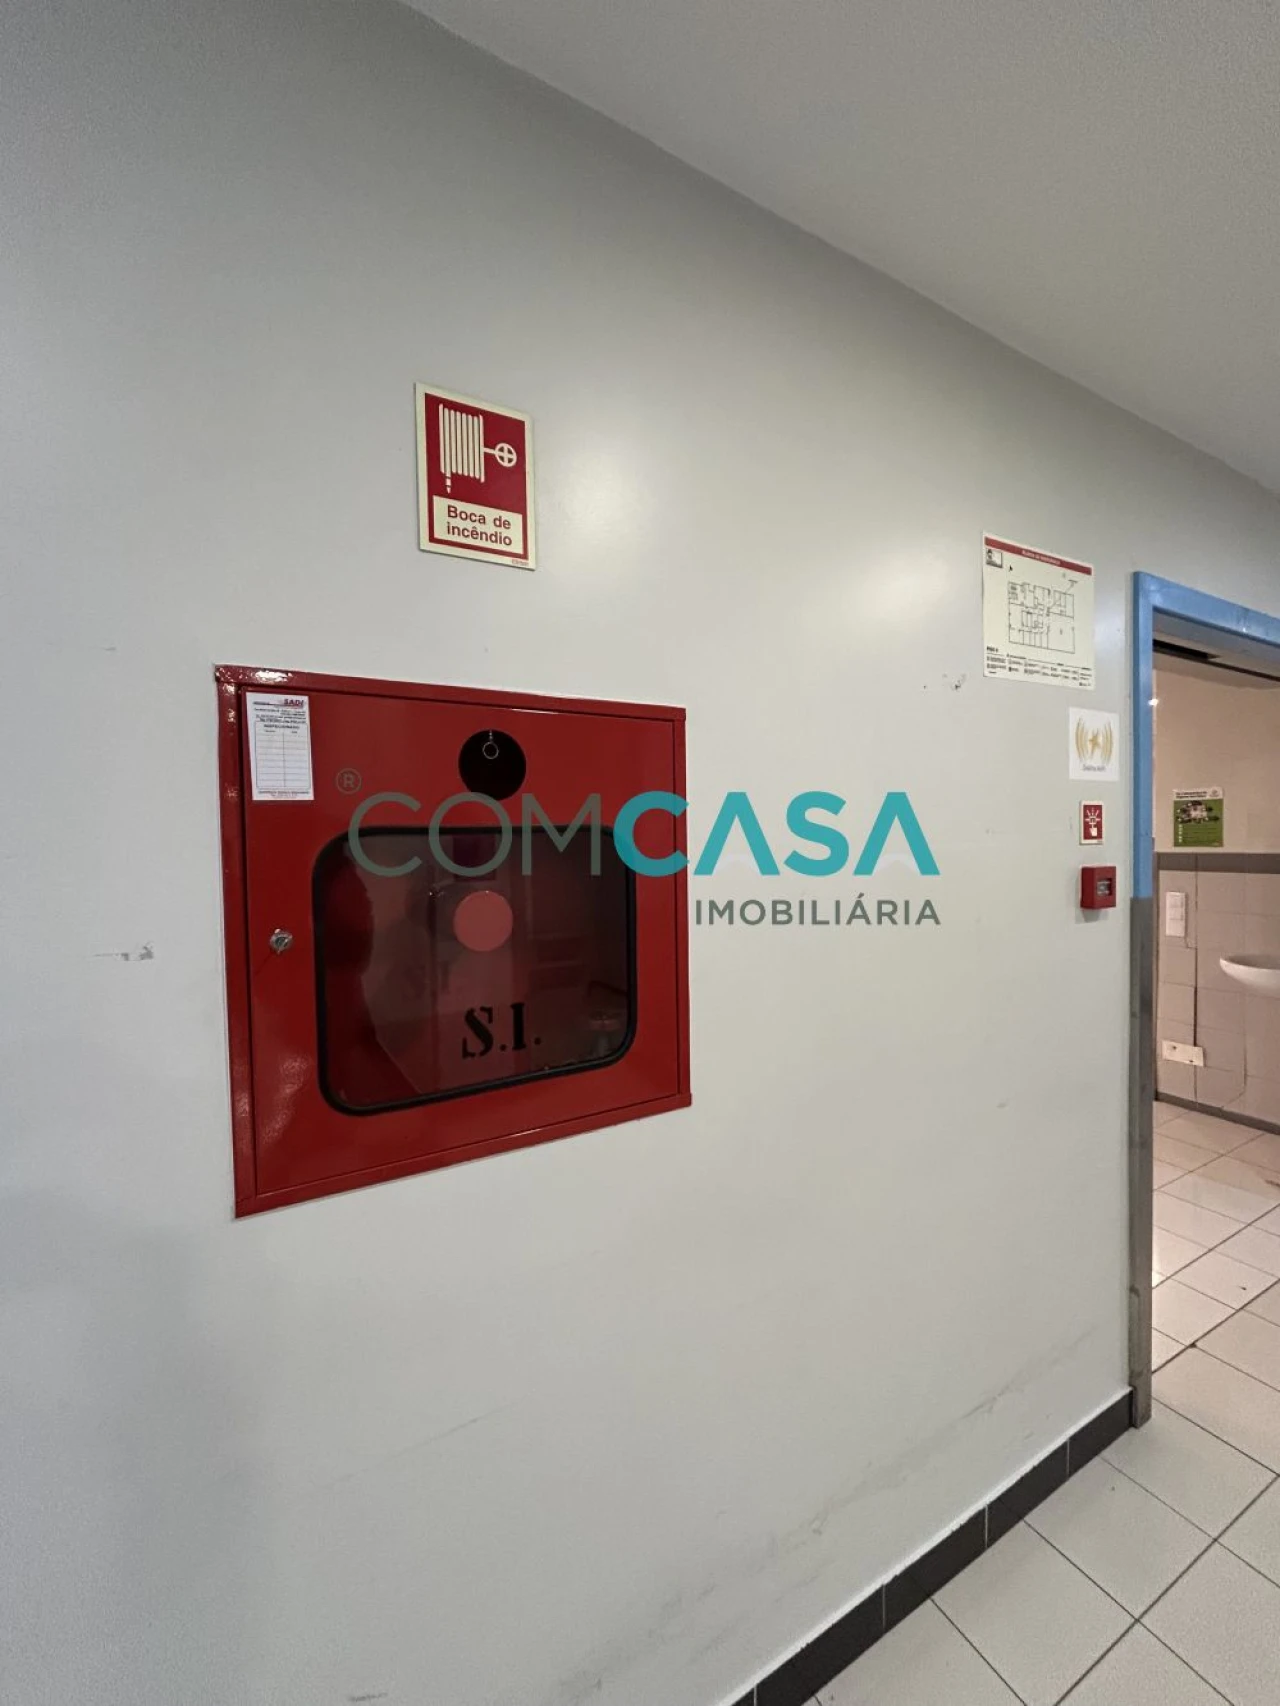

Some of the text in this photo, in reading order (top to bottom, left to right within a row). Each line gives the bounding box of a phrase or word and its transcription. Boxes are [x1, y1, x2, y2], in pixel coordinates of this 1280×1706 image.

[448, 505, 511, 529] Boca de
[447, 521, 512, 546] incêndio
[461, 1002, 542, 1060] S.I.
